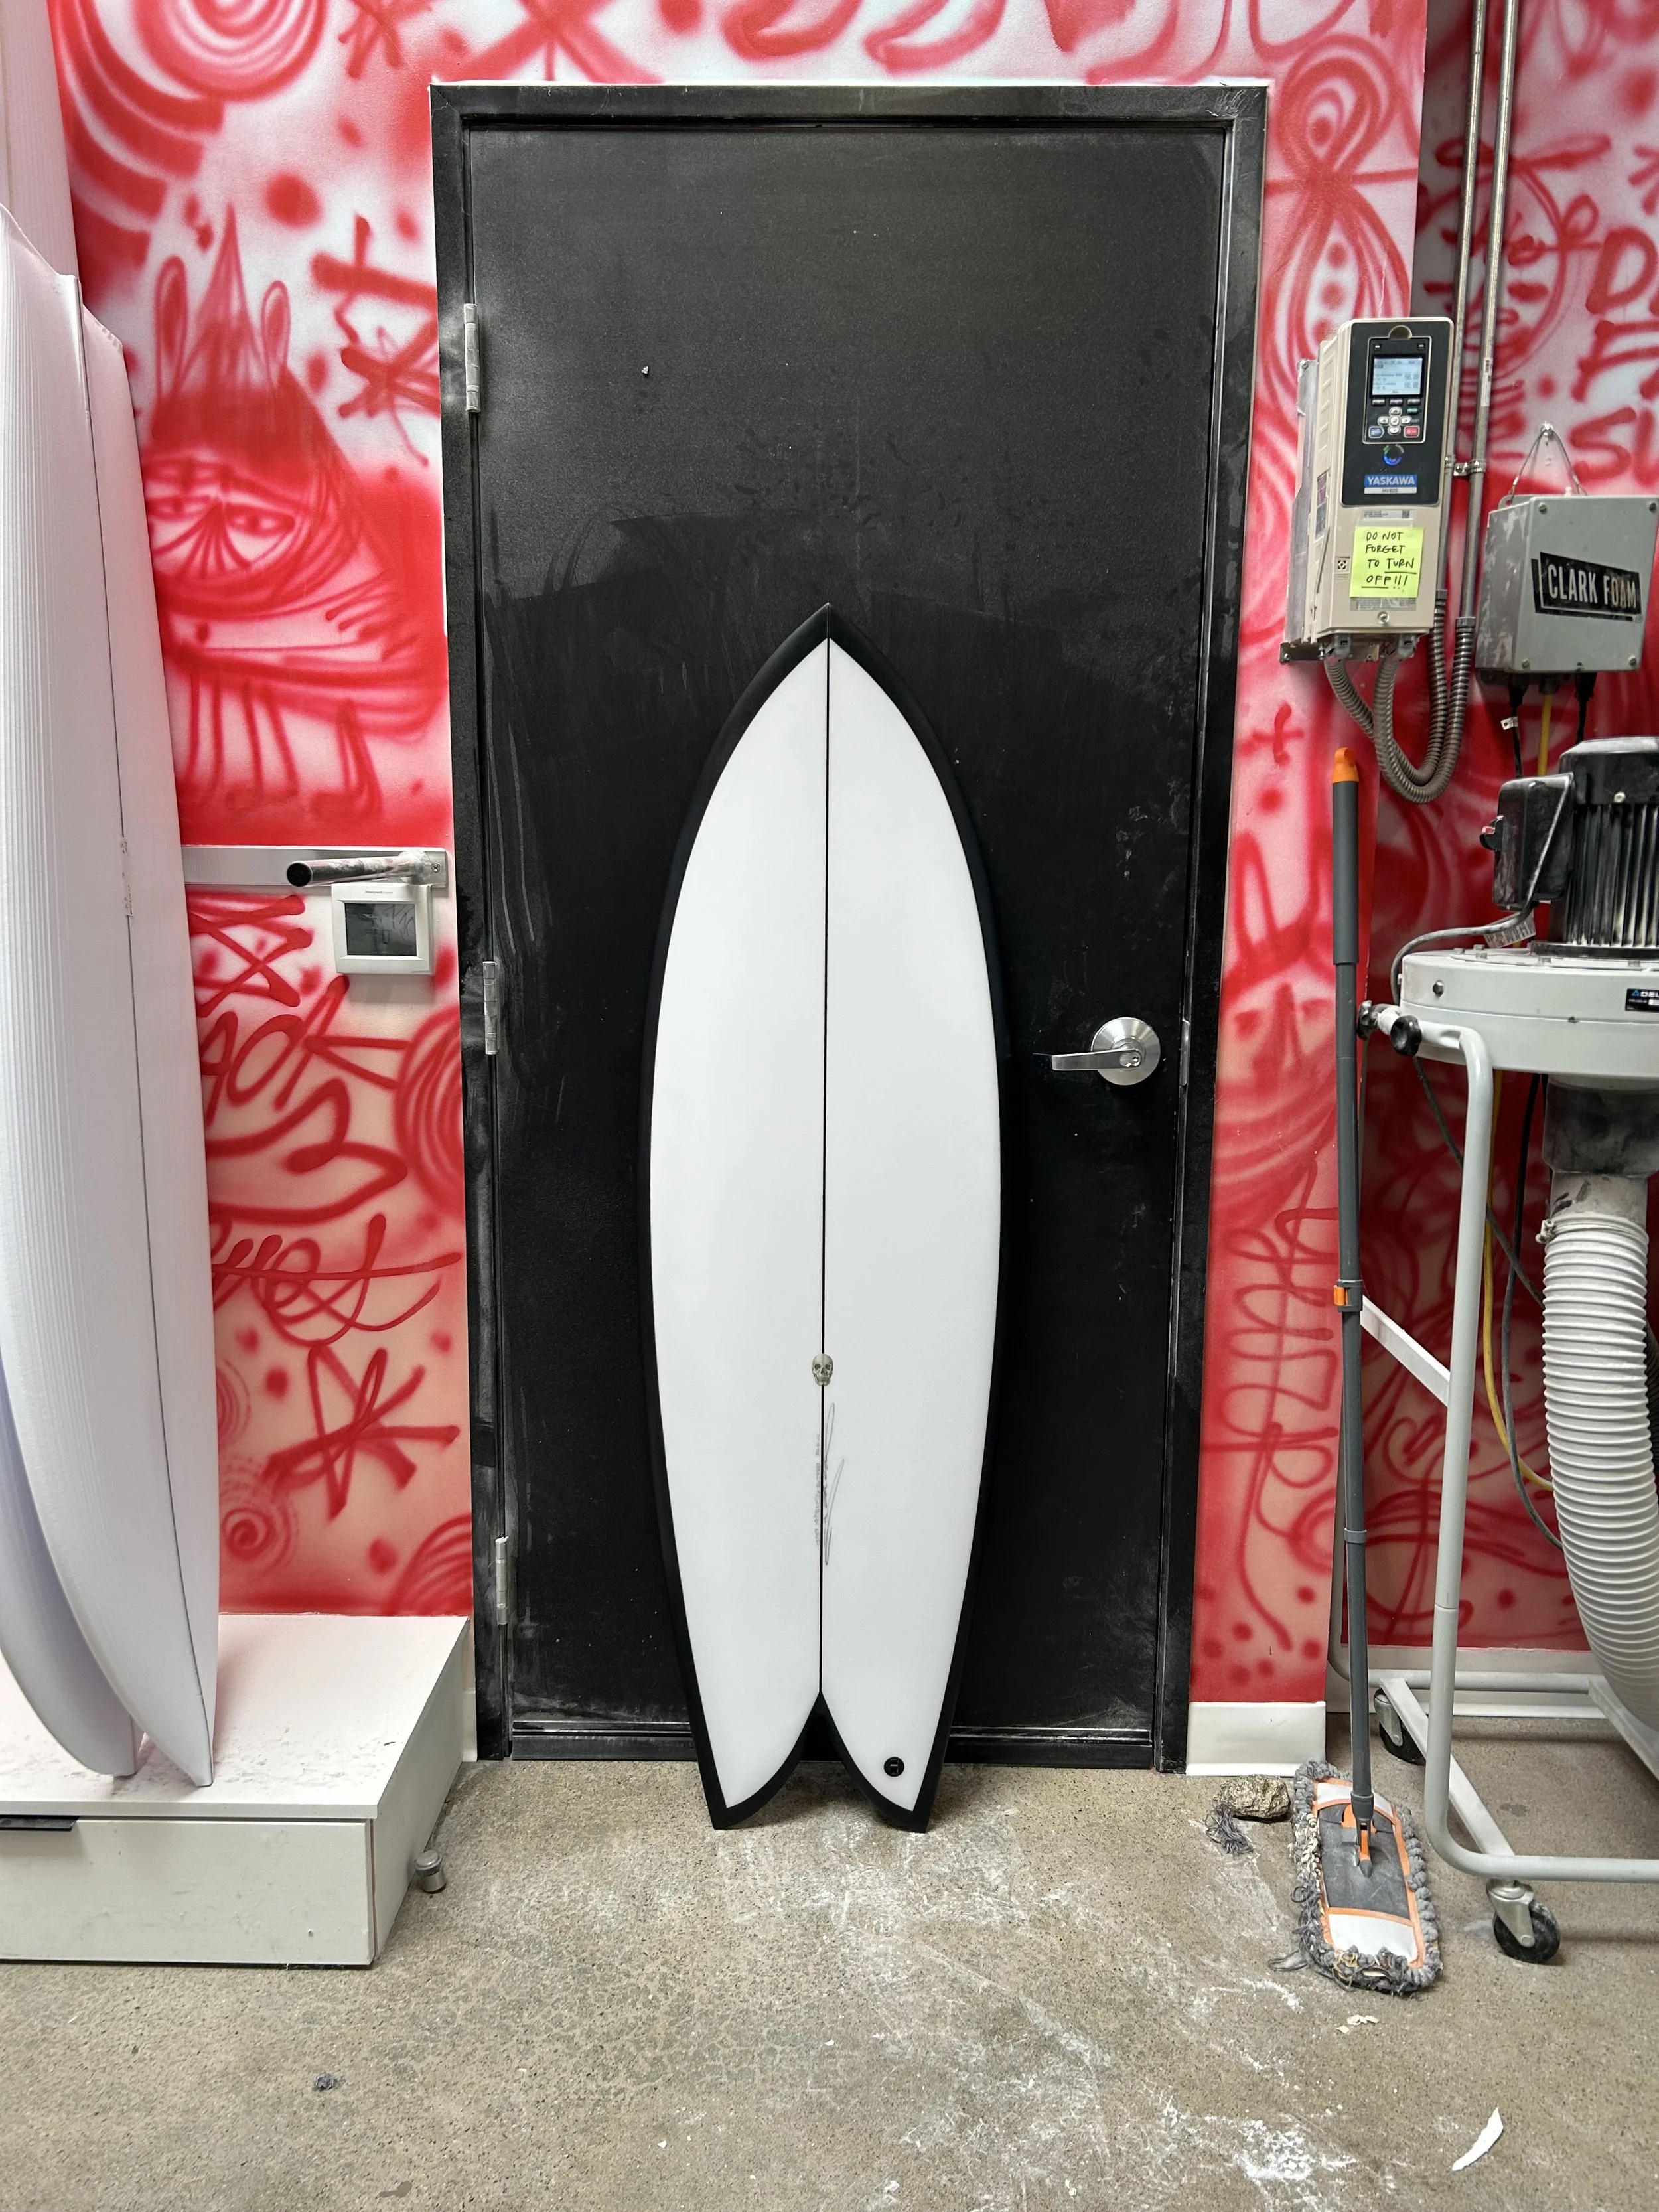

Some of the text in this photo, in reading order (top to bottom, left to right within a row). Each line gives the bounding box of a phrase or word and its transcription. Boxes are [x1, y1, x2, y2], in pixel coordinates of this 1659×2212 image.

[1368, 475, 1415, 486] YASKAWA
[1366, 531, 1403, 541] DO NOT
[1366, 544, 1406, 554] FORGET
[1368, 558, 1414, 569] TO TURN
[1548, 564, 1636, 609] CLARK FOAM
